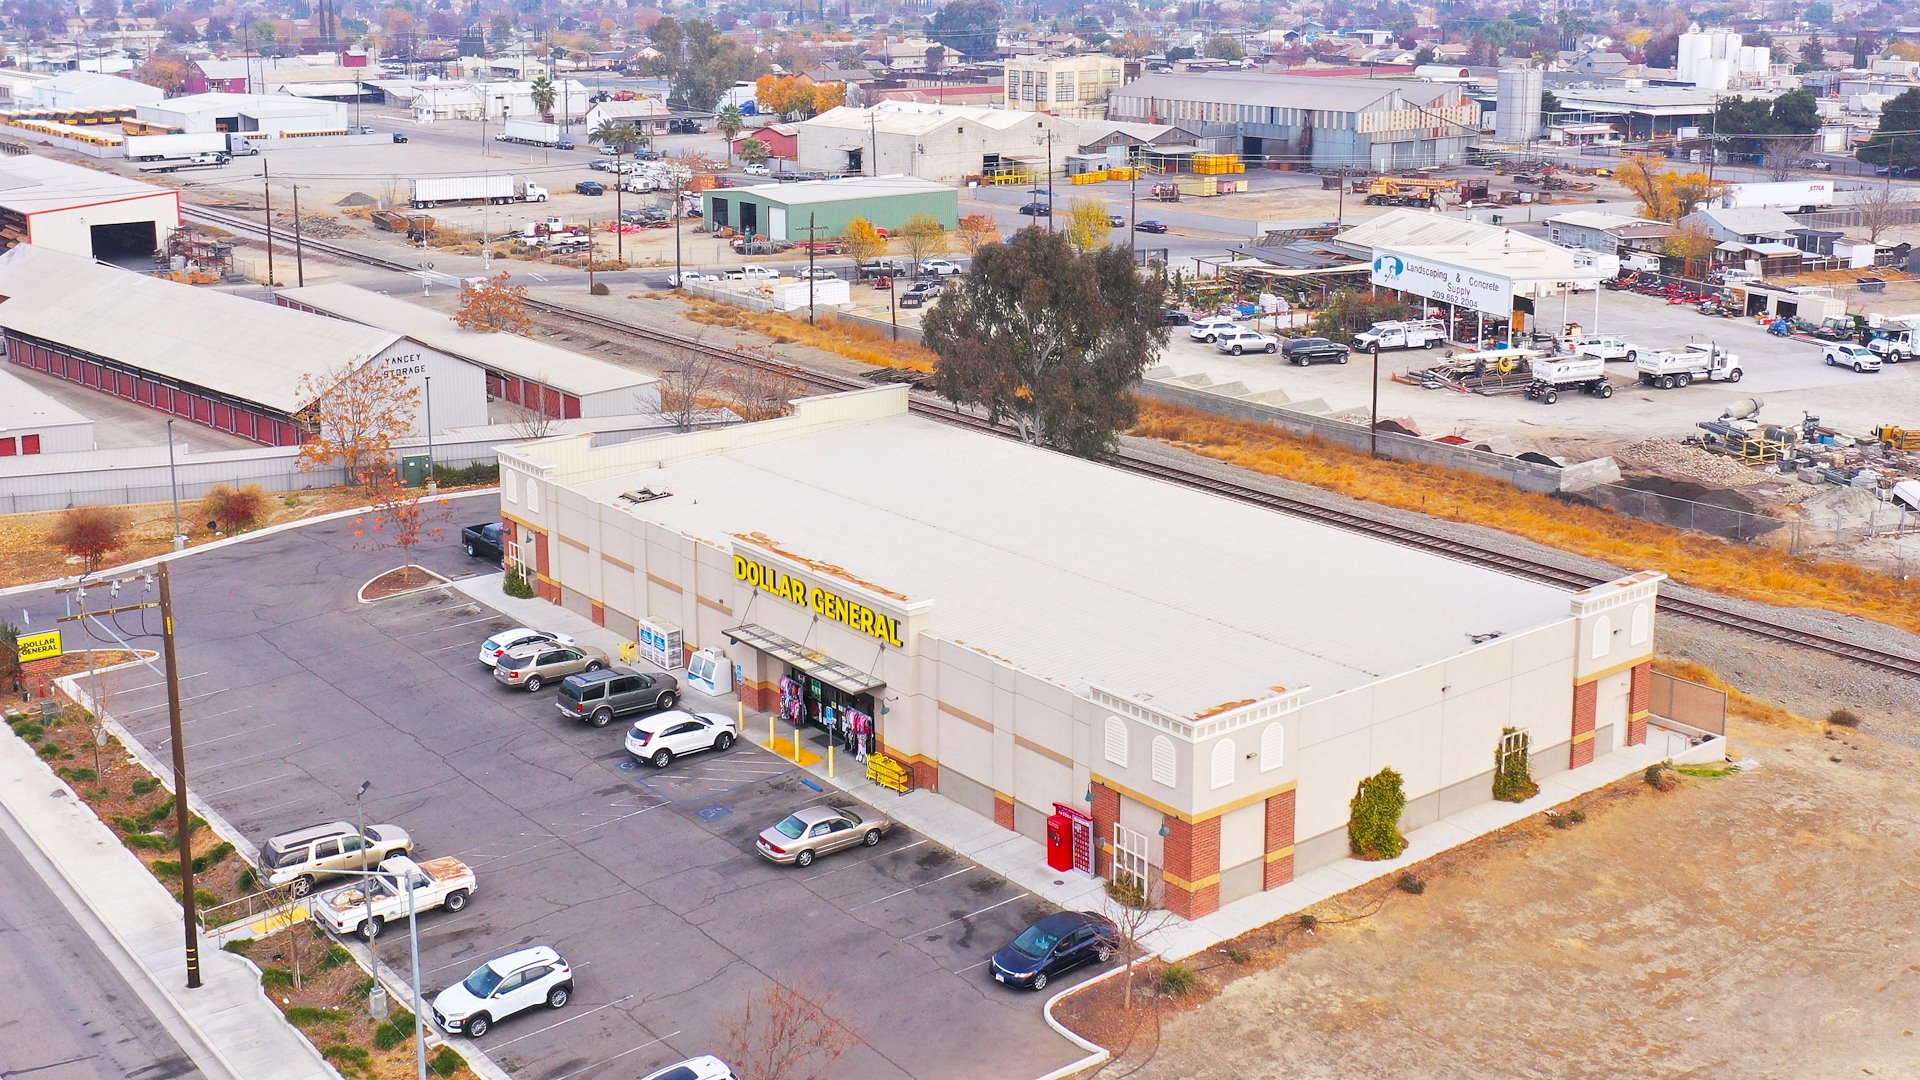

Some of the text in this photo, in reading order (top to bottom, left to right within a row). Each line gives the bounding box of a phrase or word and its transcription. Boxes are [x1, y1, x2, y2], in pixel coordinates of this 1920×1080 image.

[1406, 261, 1448, 282] Landscaping
[1455, 273, 1461, 282] &
[1468, 276, 1500, 292] Concrete
[1446, 282, 1471, 297] Supply
[385, 353, 421, 365] YANCEY
[383, 364, 426, 379] STORAGE
[733, 554, 904, 648] DOLLAR GENERAL
[21, 644, 58, 656] GENERAL
[23, 637, 56, 649] DOLLAR
